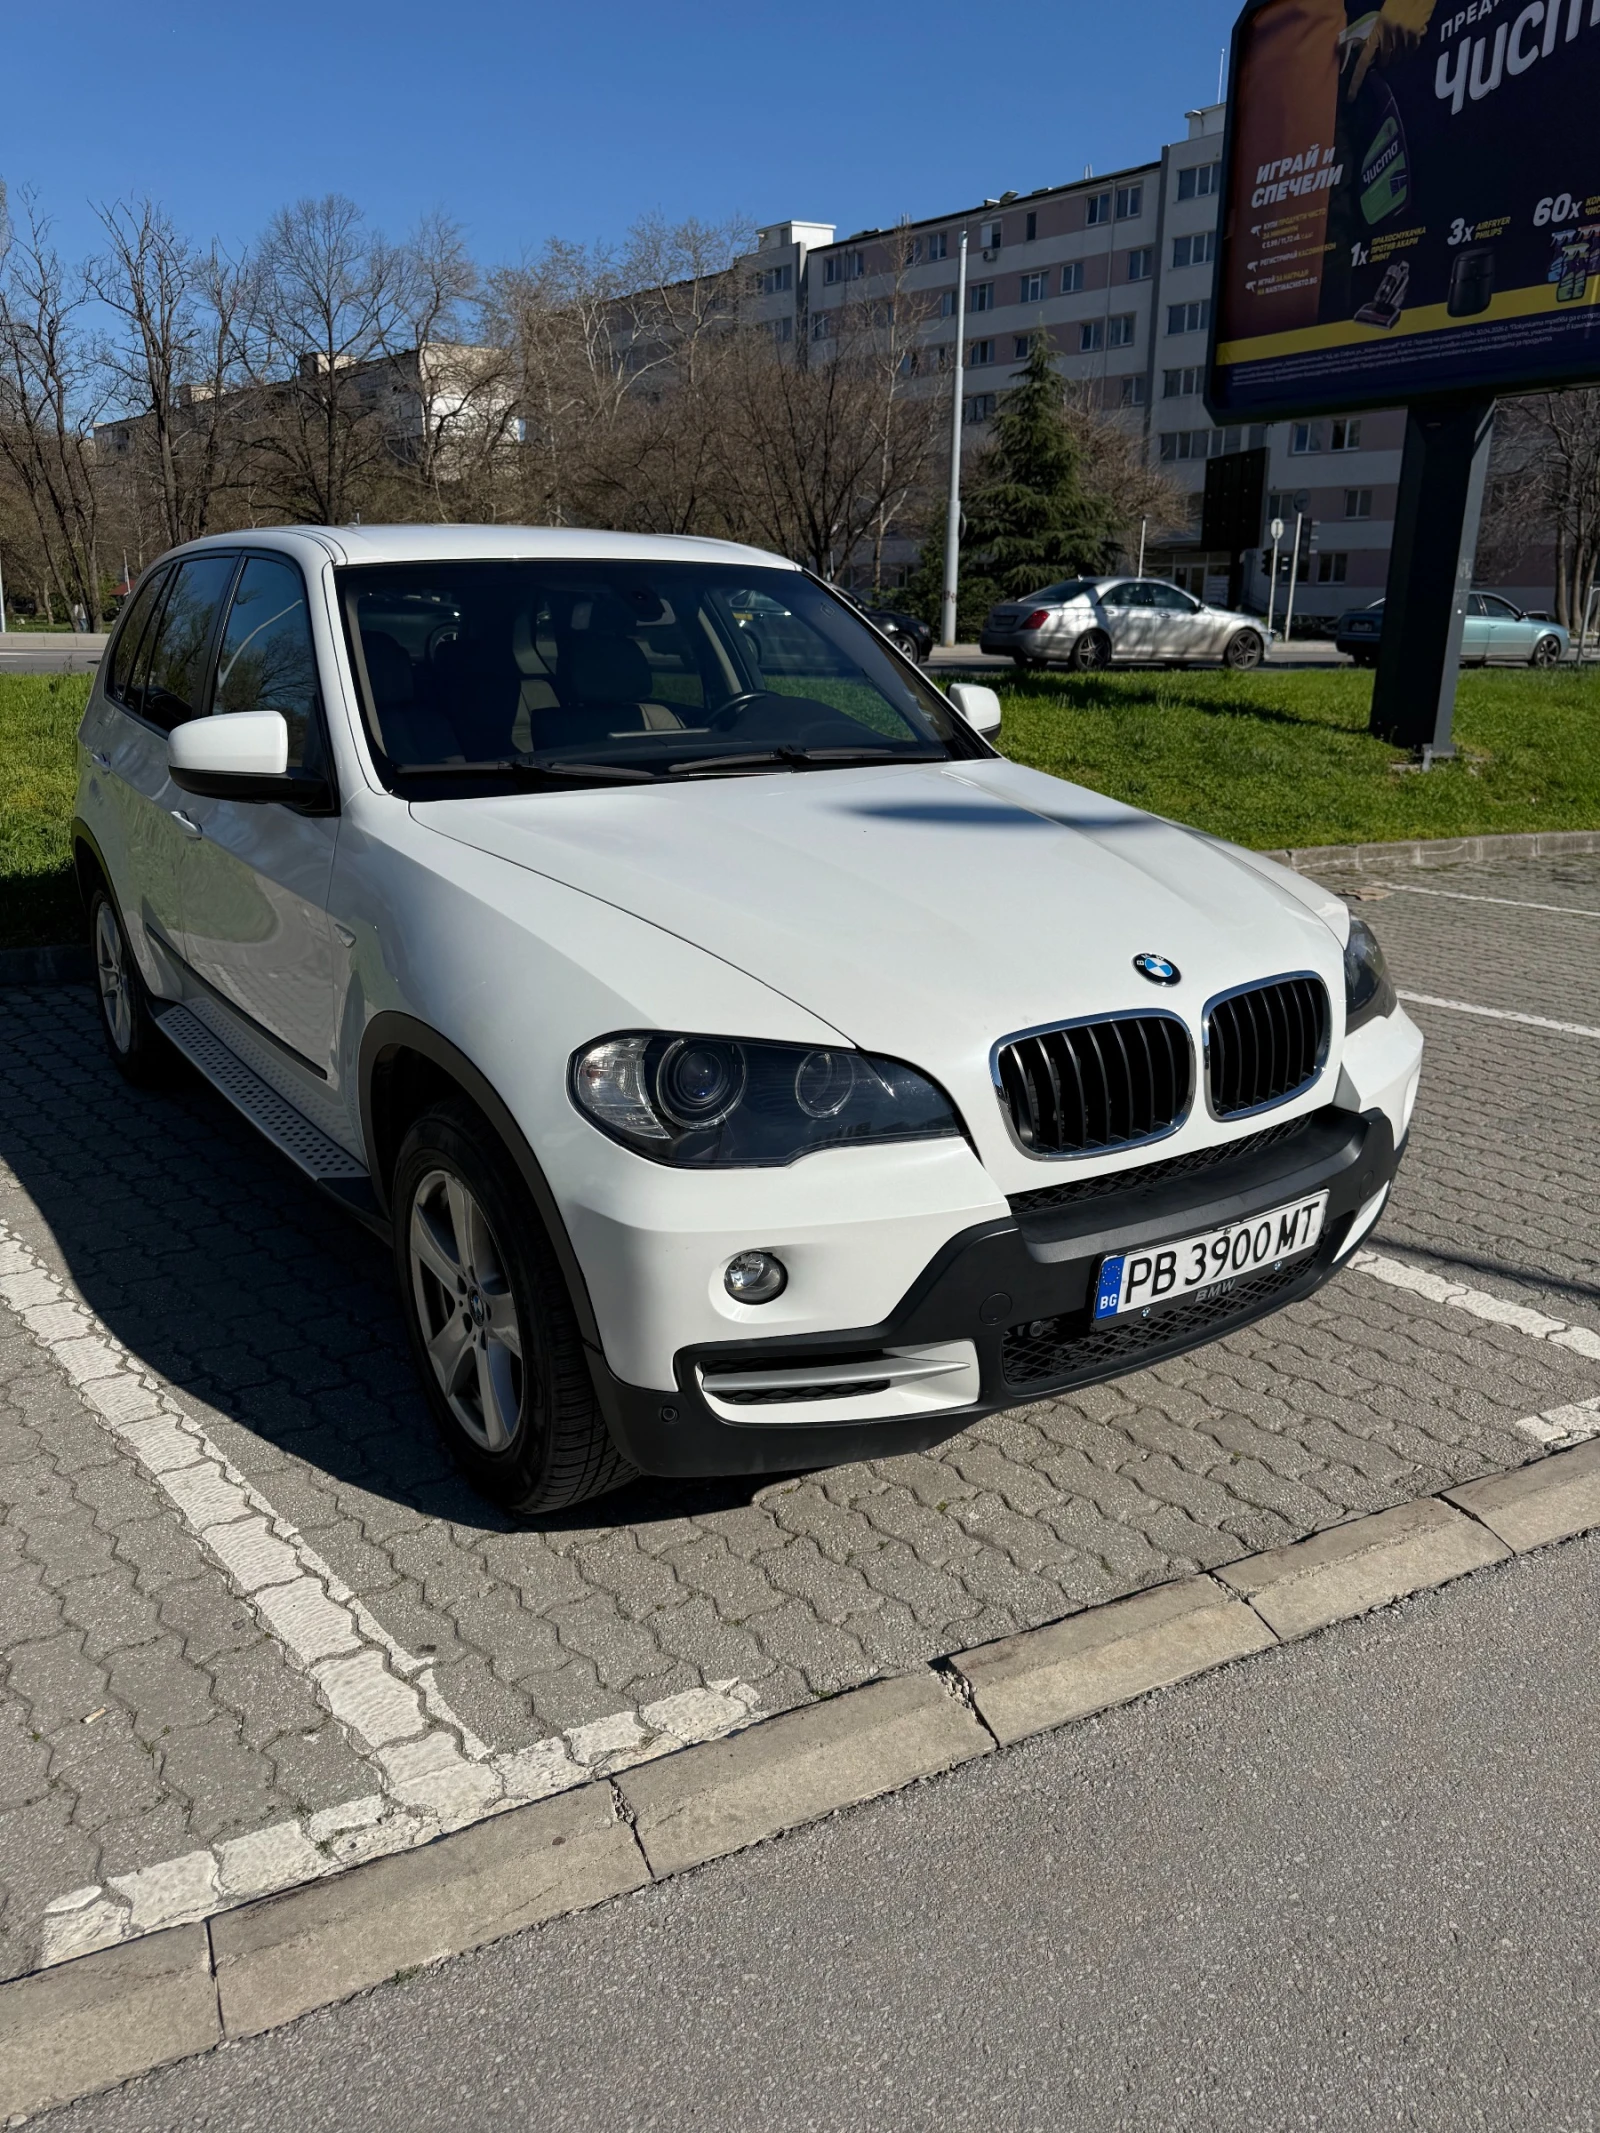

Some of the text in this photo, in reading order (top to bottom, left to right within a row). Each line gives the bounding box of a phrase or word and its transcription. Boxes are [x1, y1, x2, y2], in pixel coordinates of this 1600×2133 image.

[1255, 143, 1320, 185] ИГРАЙ
[1251, 164, 1344, 209] СПЕЧЕЛИ
[1474, 227, 1503, 240] PHILIPS
[1475, 216, 1511, 231] AIRFRYER
[1370, 236, 1419, 255] ПРОТИВ АКАРИ
[1371, 225, 1427, 246] ПРАХОСМУКАЧКА
[1260, 250, 1298, 267] РЕГИСТРИРАЙ
[1257, 275, 1276, 287] ИГРАЙ
[1099, 1293, 1117, 1310] BG
[1185, 1221, 1271, 1286] 3900
[1195, 1278, 1236, 1302] BMW
